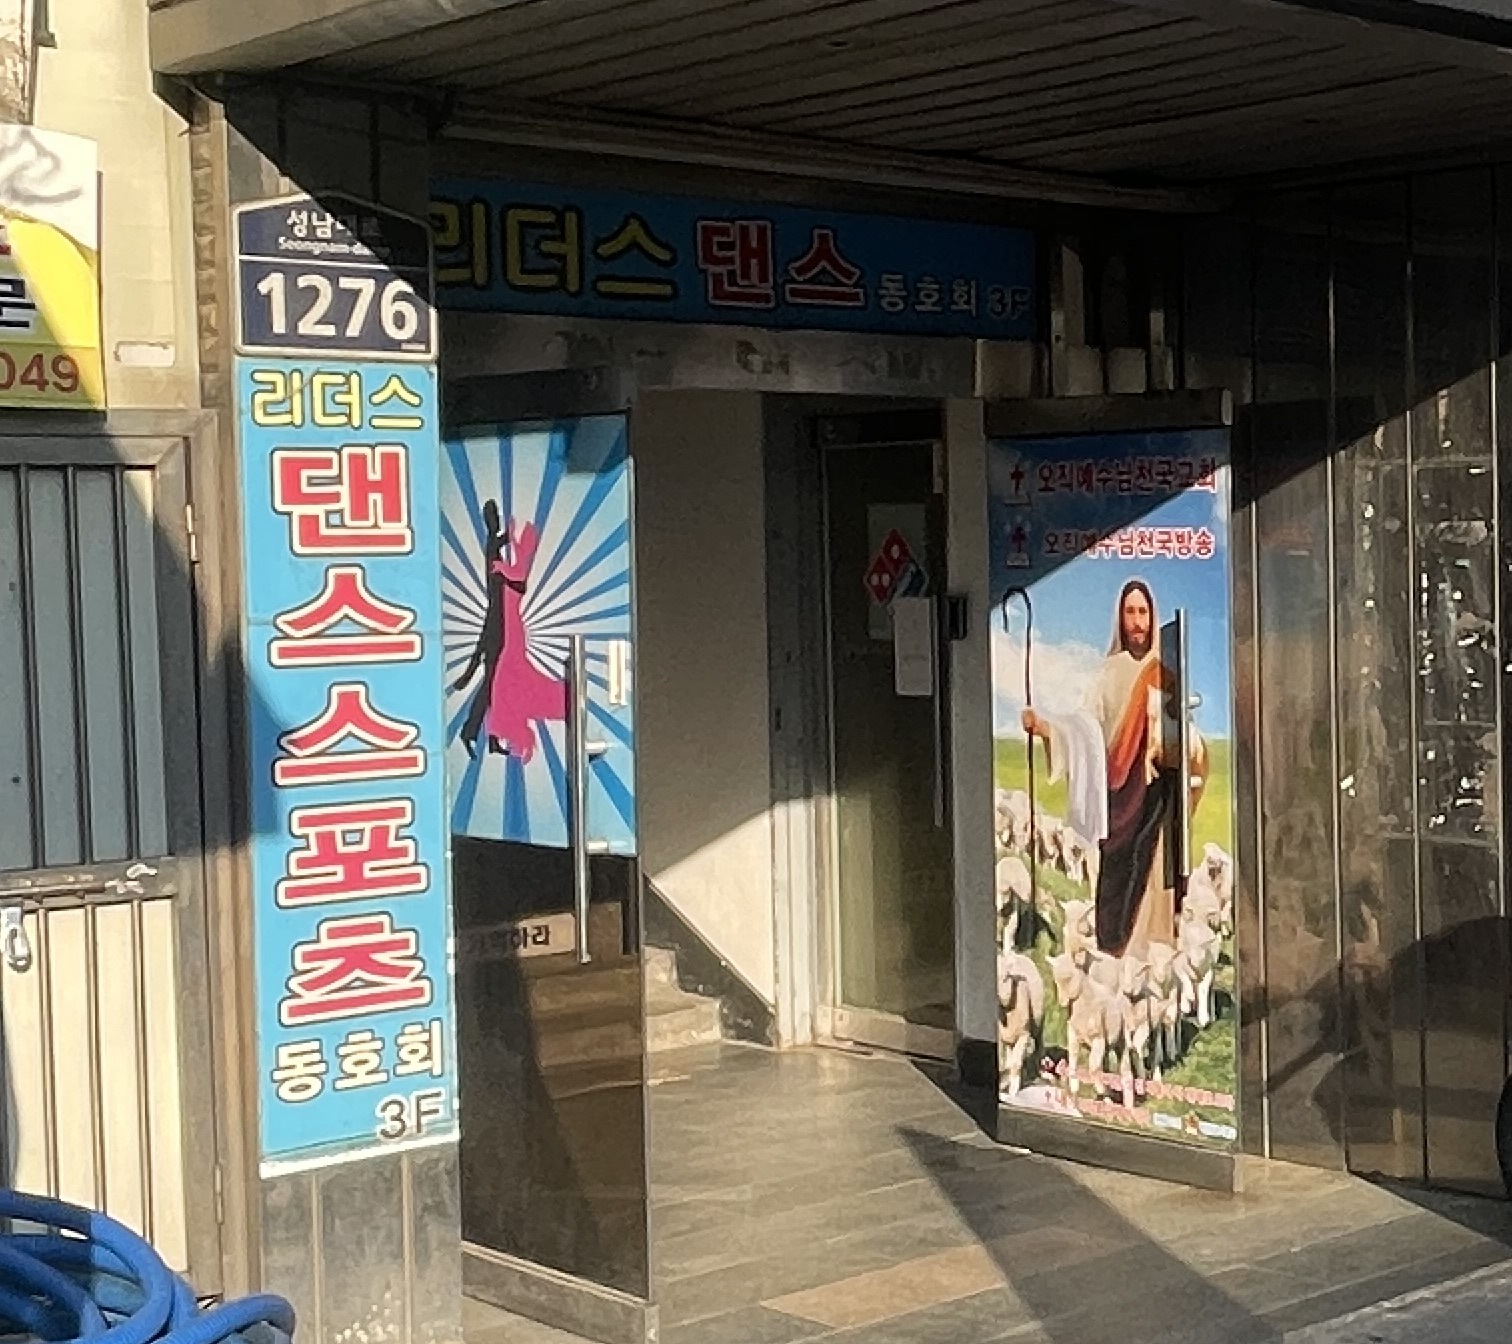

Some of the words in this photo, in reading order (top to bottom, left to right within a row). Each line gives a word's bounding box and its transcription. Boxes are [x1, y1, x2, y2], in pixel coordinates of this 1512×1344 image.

[694, 218, 867, 309] 댄스
[876, 270, 980, 320] 동호회
[255, 271, 420, 342] 1276
[249, 367, 426, 432] 리더스
[269, 1016, 447, 1105] 동호회
[375, 1086, 447, 1143] 3F
